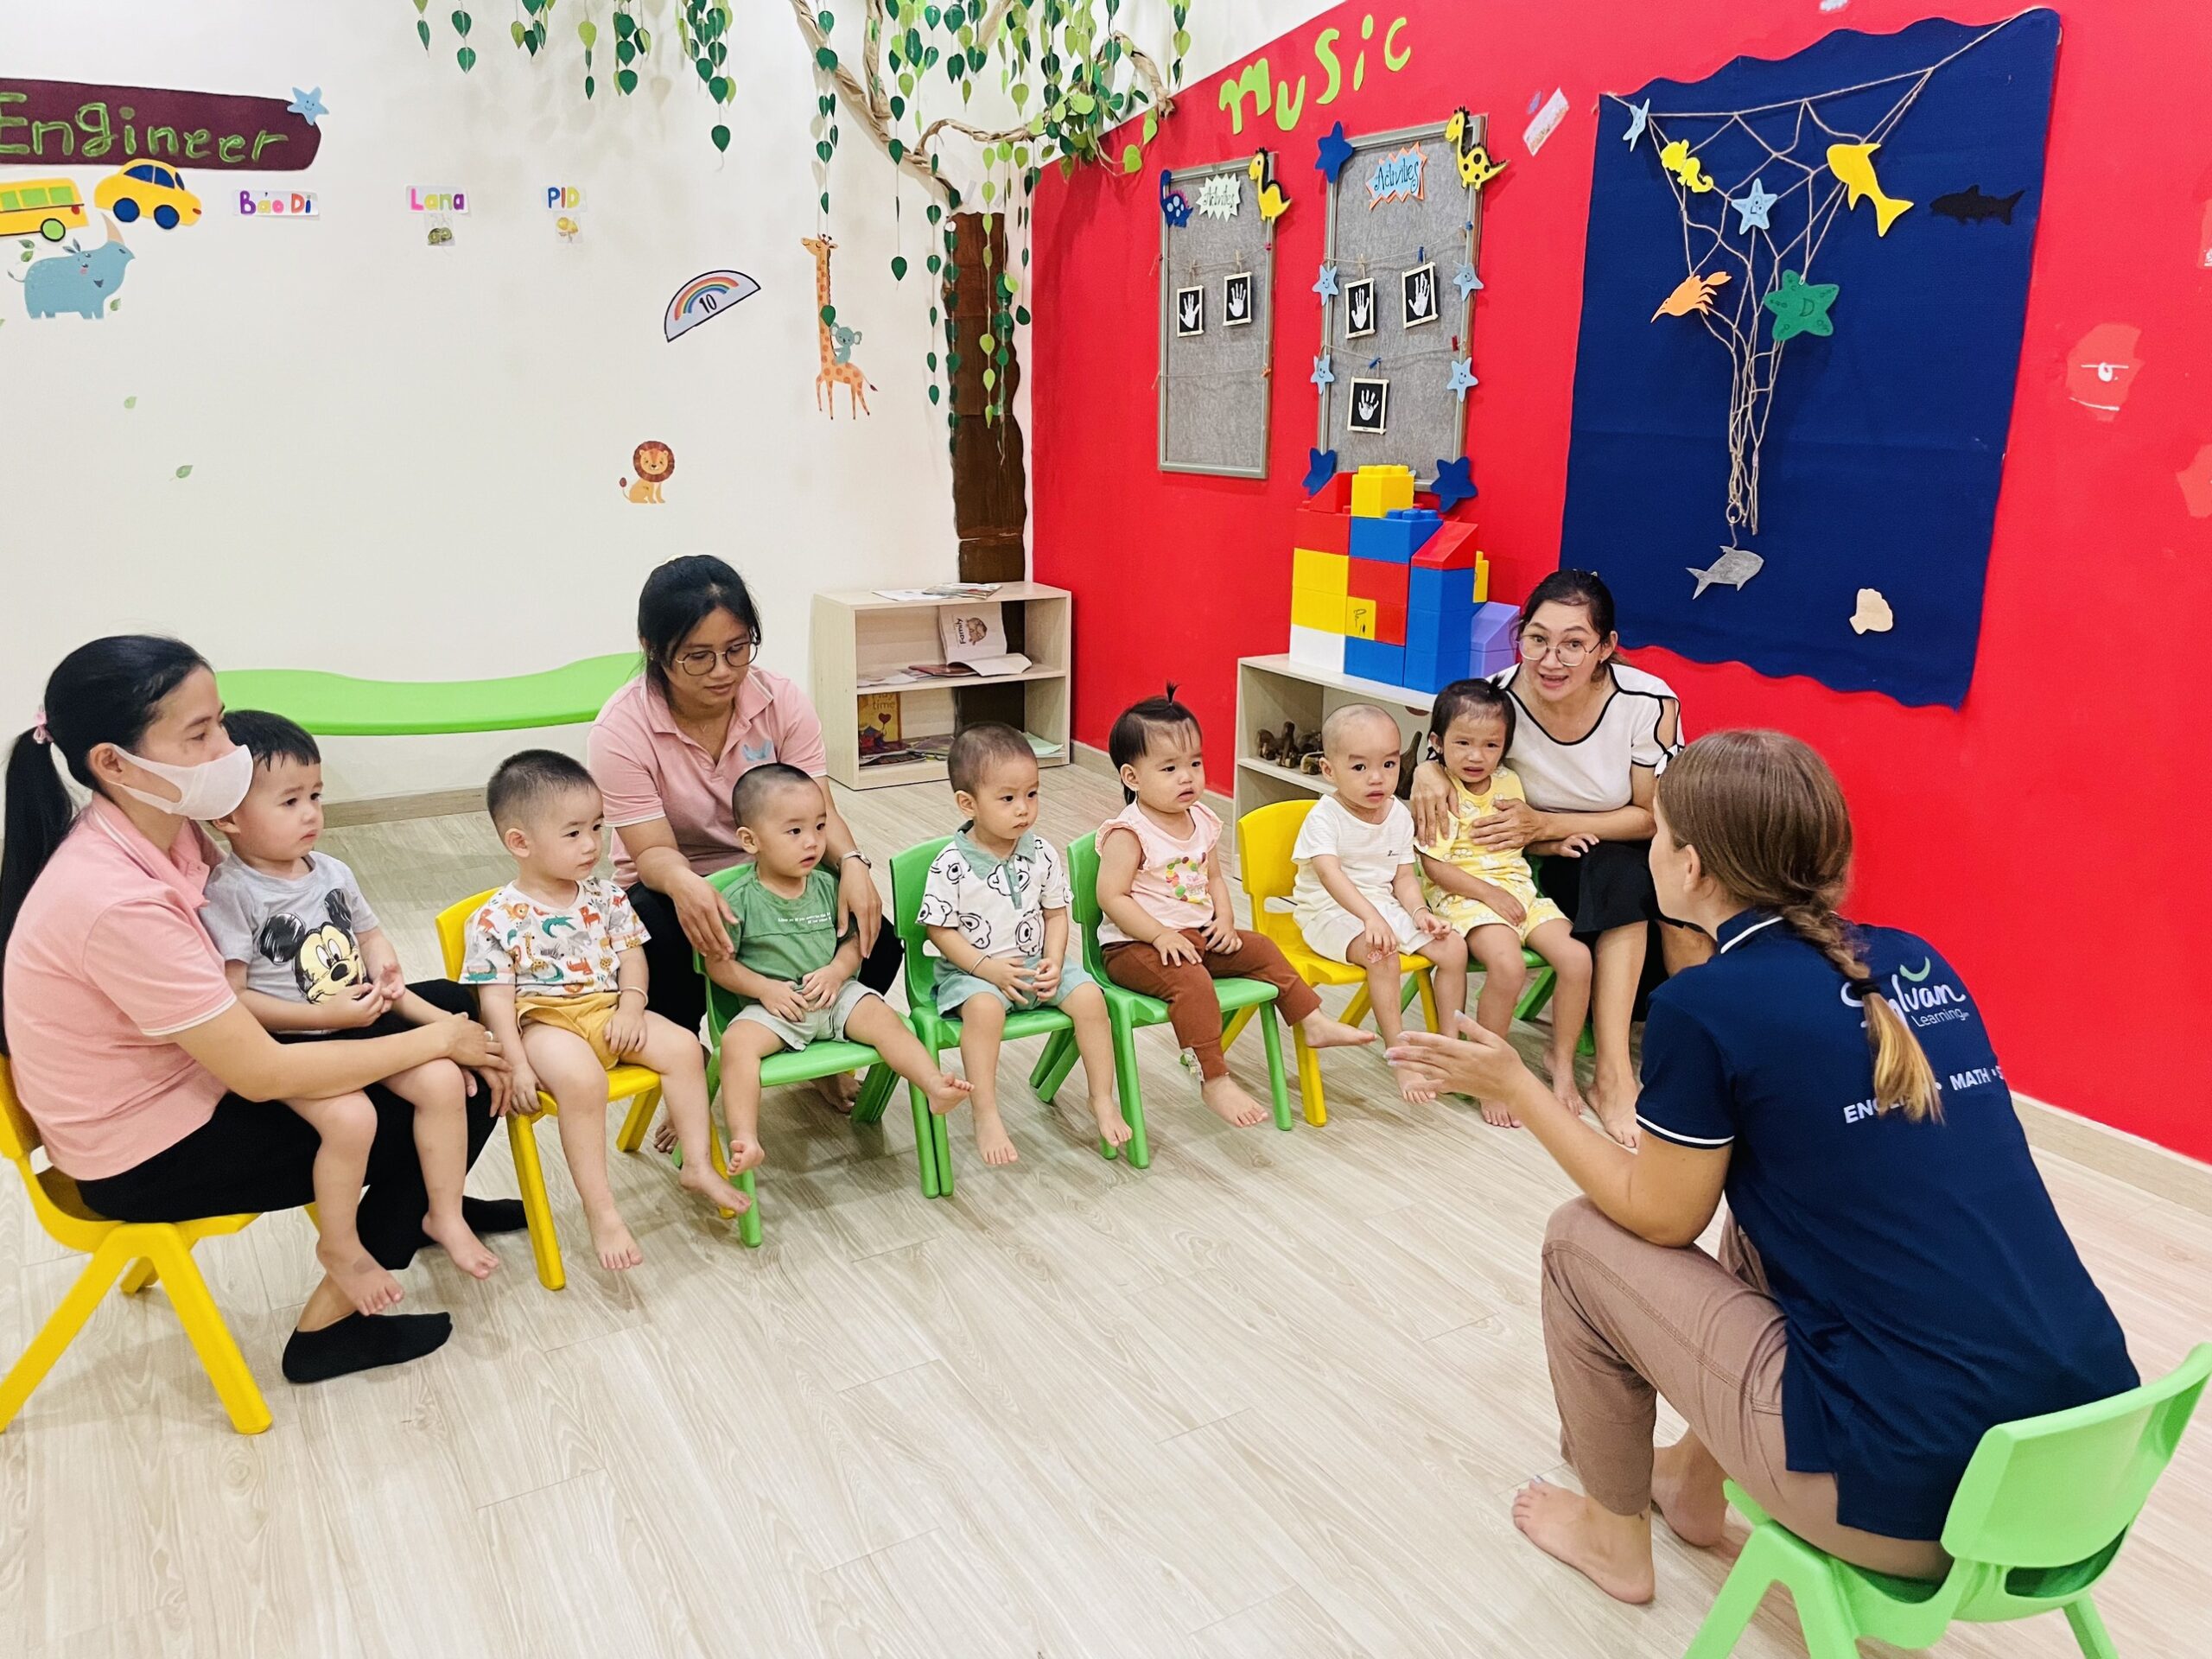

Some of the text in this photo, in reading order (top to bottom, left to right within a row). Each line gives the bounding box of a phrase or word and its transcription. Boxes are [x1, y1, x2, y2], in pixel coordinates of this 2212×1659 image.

[0, 92, 289, 163] Engineer
[410, 188, 465, 211] Lana
[699, 294, 717, 314] 10
[1949, 1067, 1992, 1090] MATH
